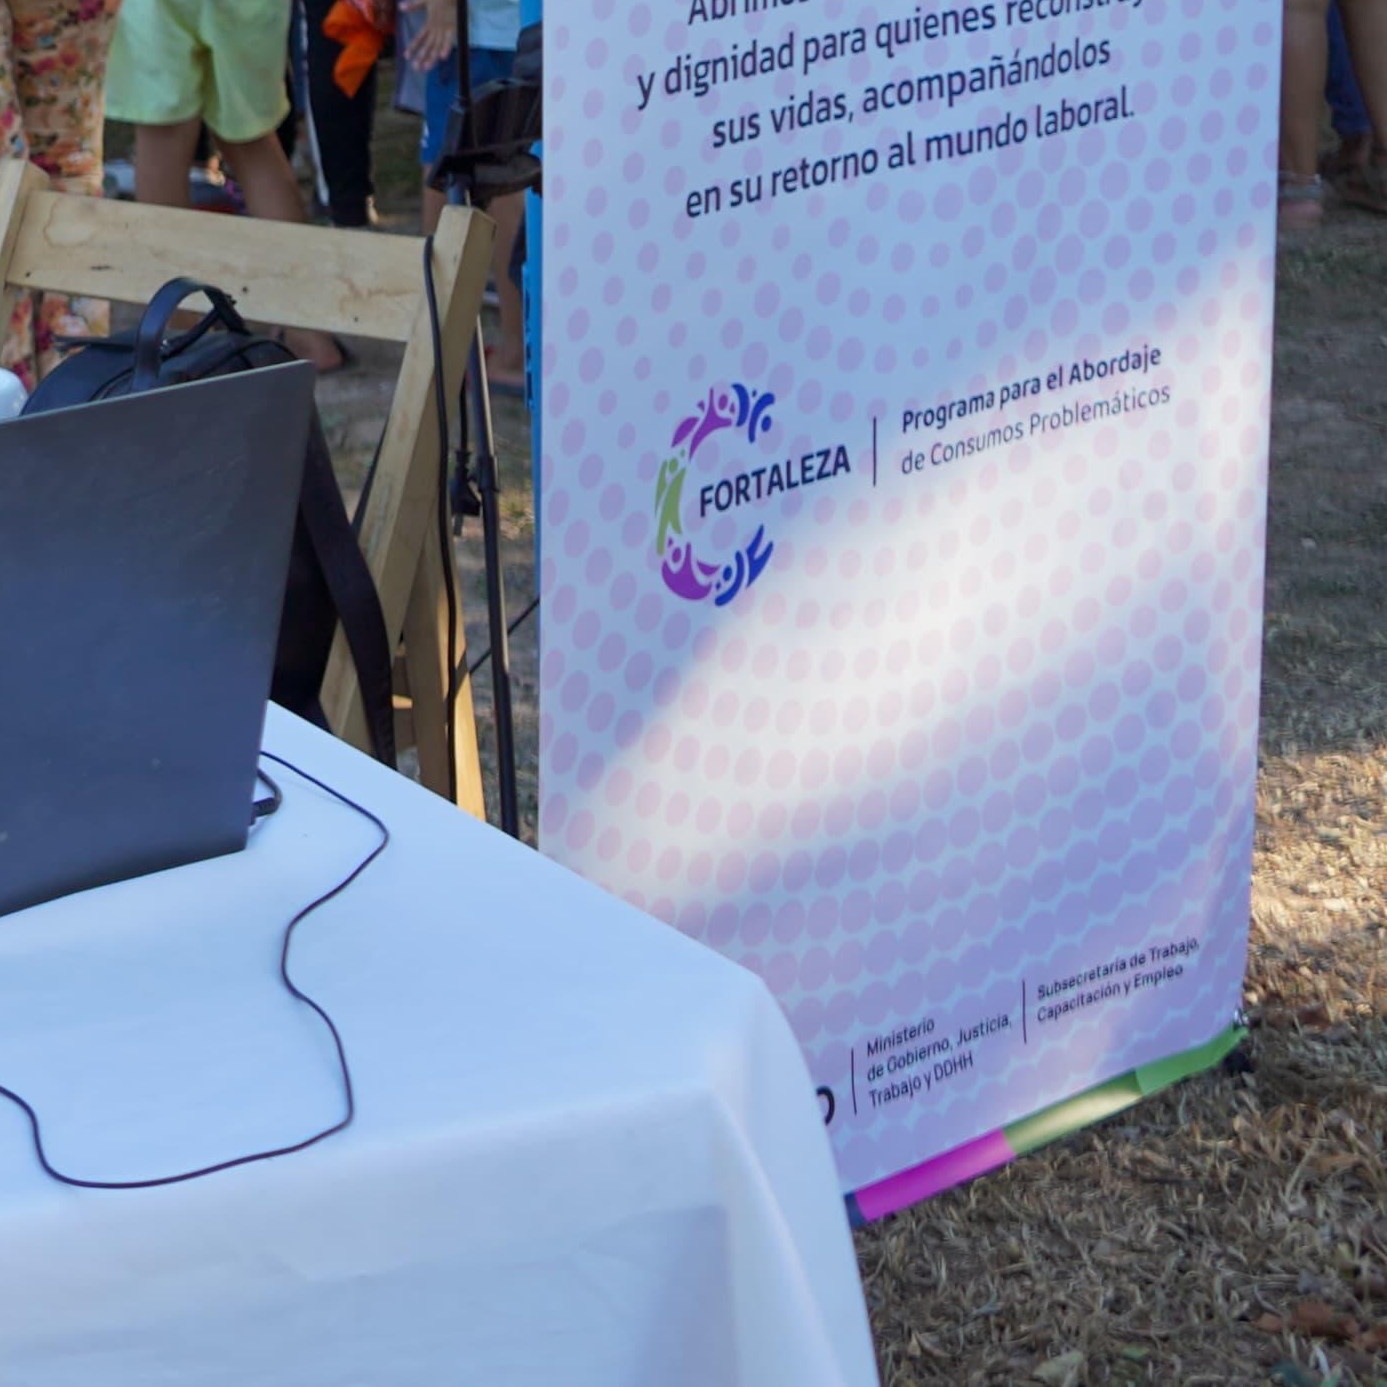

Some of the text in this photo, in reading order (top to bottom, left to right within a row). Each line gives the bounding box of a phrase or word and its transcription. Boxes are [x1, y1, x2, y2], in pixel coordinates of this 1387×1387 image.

[637, 69, 656, 110] y
[664, 31, 795, 98] dignidad
[802, 26, 867, 75] para
[875, 1, 997, 59] quienes
[712, 37, 1112, 148] sus vidas, acompañándolos
[685, 84, 1136, 218] en su retorno al mundo laboral.
[901, 343, 1163, 435] Programa para el Abordaje
[901, 382, 1171, 477] de Consumos Problemáticos
[698, 443, 852, 518] FORTALEZA
[1036, 955, 1127, 1002] Subsecretaría
[1129, 949, 1146, 969] de
[1036, 964, 1184, 1024] Capacitación y Empleo
[866, 1017, 936, 1058] Ministerio
[867, 1062, 884, 1082] de
[868, 1078, 923, 1109] Trabajo
[924, 1074, 933, 1094] y
[934, 1052, 974, 1082] DDHH
